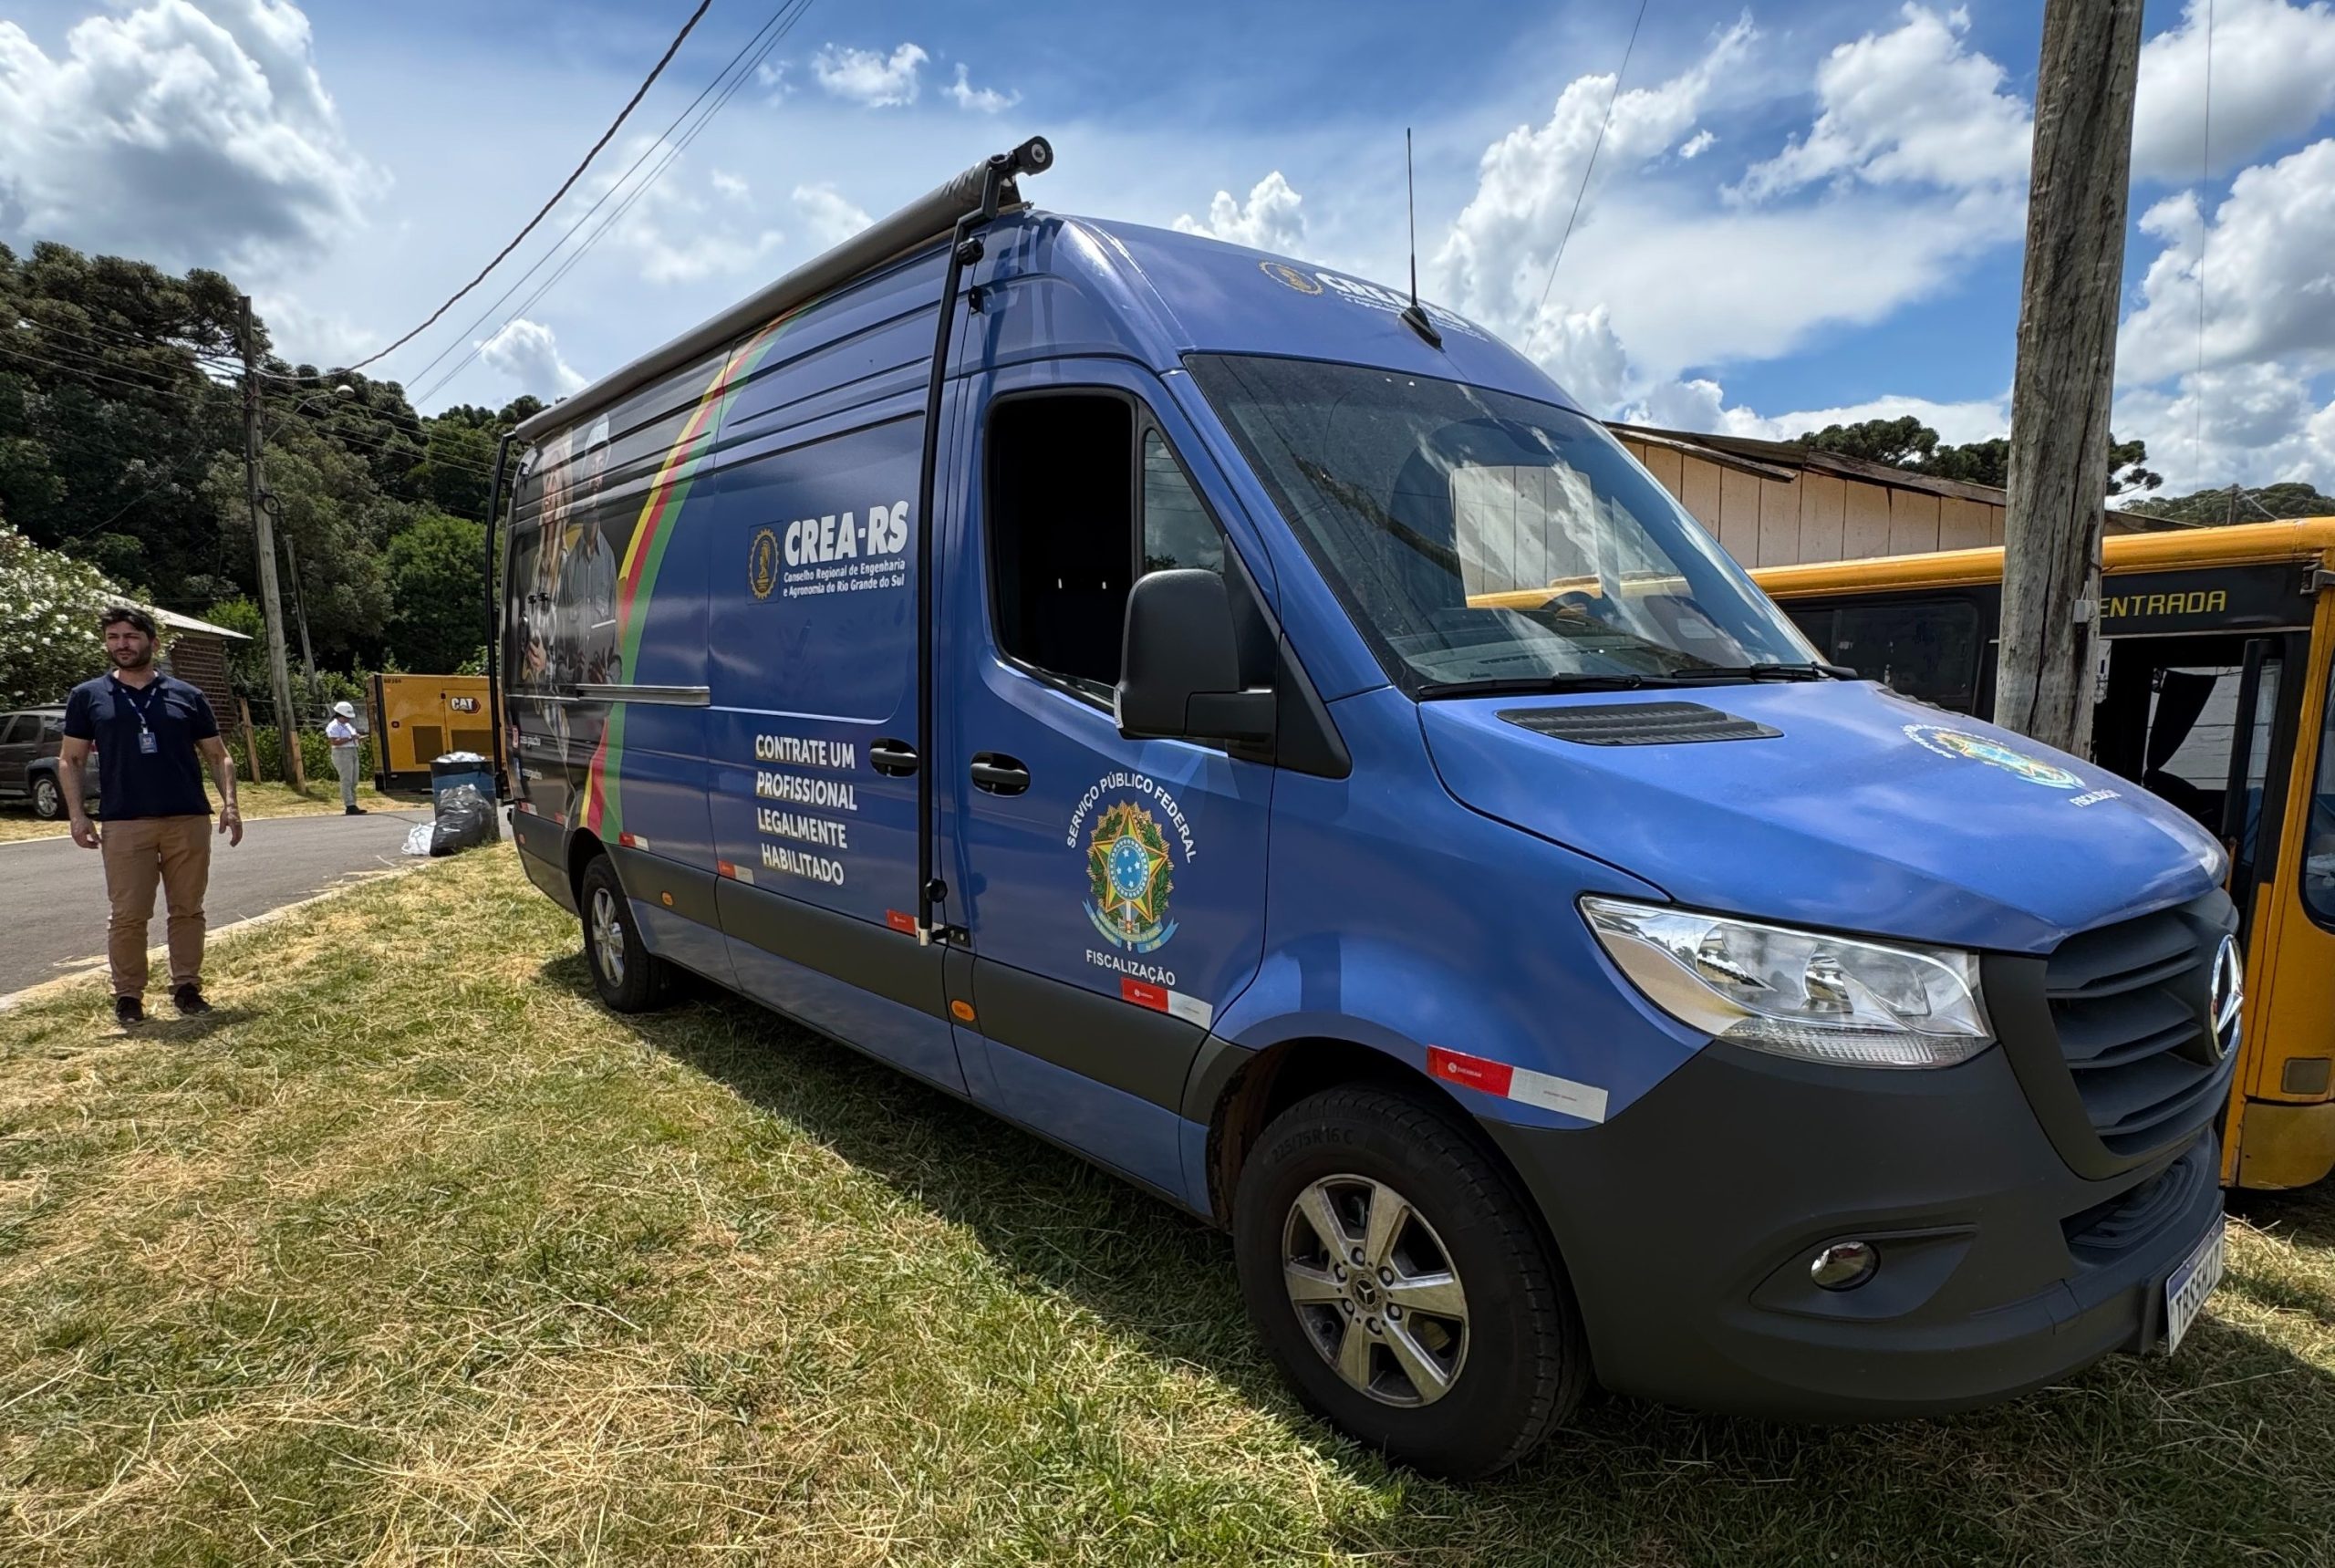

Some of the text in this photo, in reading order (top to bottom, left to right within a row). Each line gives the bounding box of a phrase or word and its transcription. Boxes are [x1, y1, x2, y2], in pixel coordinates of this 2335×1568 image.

[784, 501, 908, 566] CREA-RS
[784, 558, 906, 583] Conselho Regional de Engenharia
[784, 574, 904, 598] e Agronomia do Rio Grande do Sul
[2100, 590, 2226, 618] ENTRADA
[451, 698, 473, 711] CAT
[755, 734, 856, 769] CONTRATE UM
[756, 771, 857, 811] PROFISSIONAL
[757, 807, 847, 849] LEGALMENTE
[1066, 771, 1198, 864] SERVIÇO PÚBLICO FEDERAL
[762, 843, 844, 886] HABILITADO
[1085, 949, 1176, 986] FISCALIZAÇÃO
